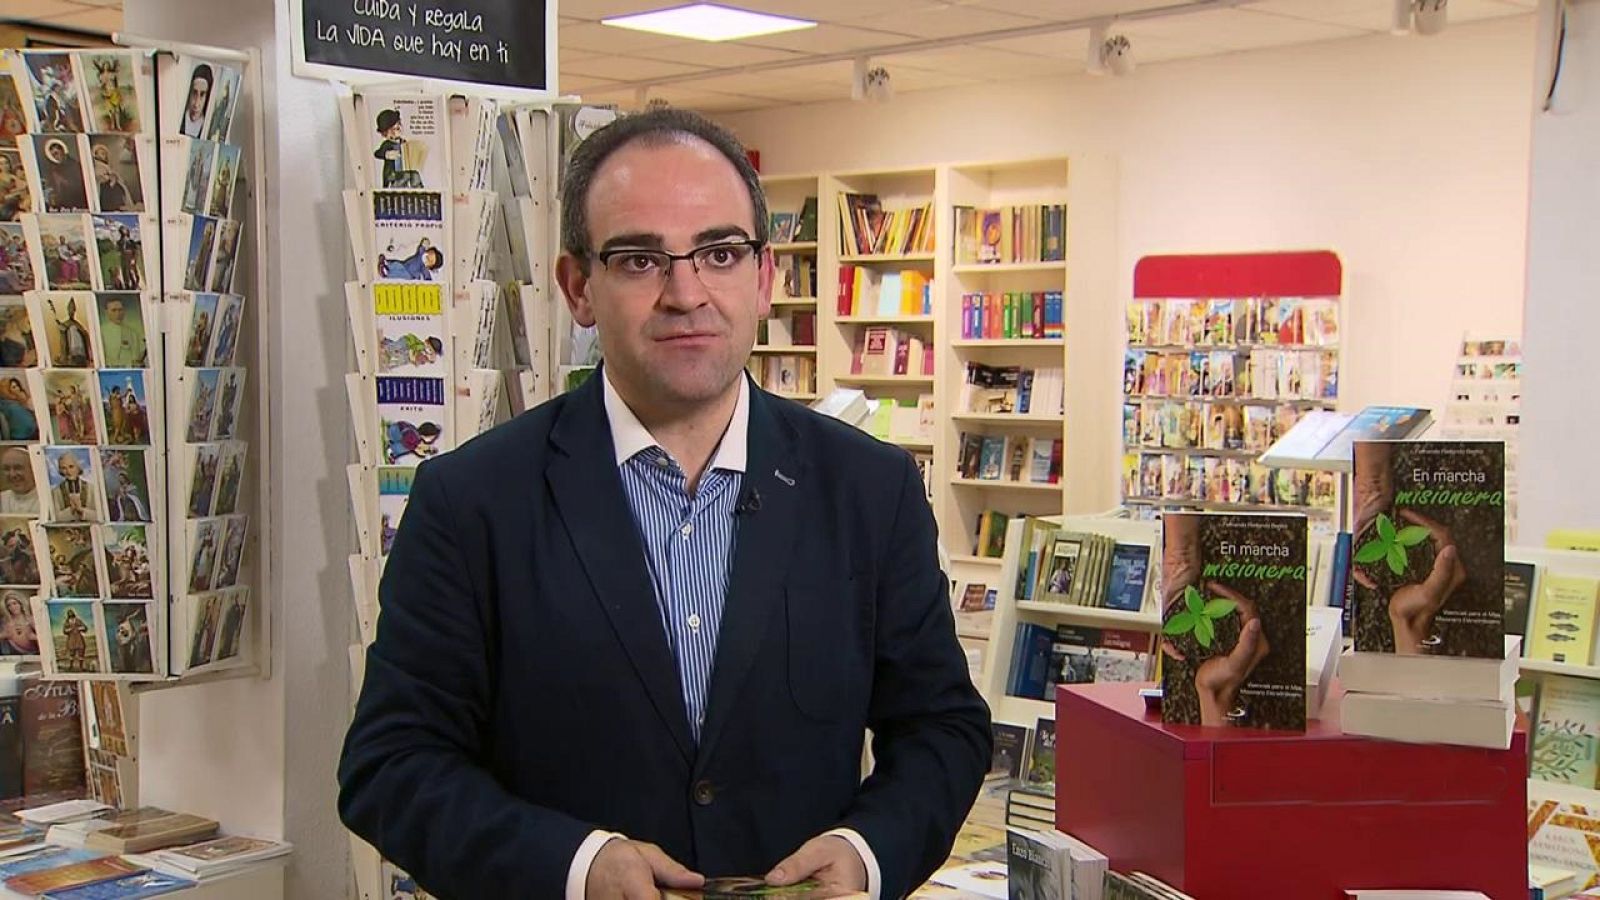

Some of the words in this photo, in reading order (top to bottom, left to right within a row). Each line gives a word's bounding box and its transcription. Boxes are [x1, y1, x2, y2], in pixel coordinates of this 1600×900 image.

[346, 23, 386, 48] VIDA
[431, 33, 463, 63] hay
[469, 42, 490, 63] en
[497, 40, 509, 64] ti
[1413, 468, 1430, 482] En
[1433, 468, 1486, 483] marcha
[1394, 488, 1503, 506] misionera
[1220, 541, 1236, 556] En
[1239, 542, 1290, 557] marcha
[1202, 562, 1306, 580] misionera
